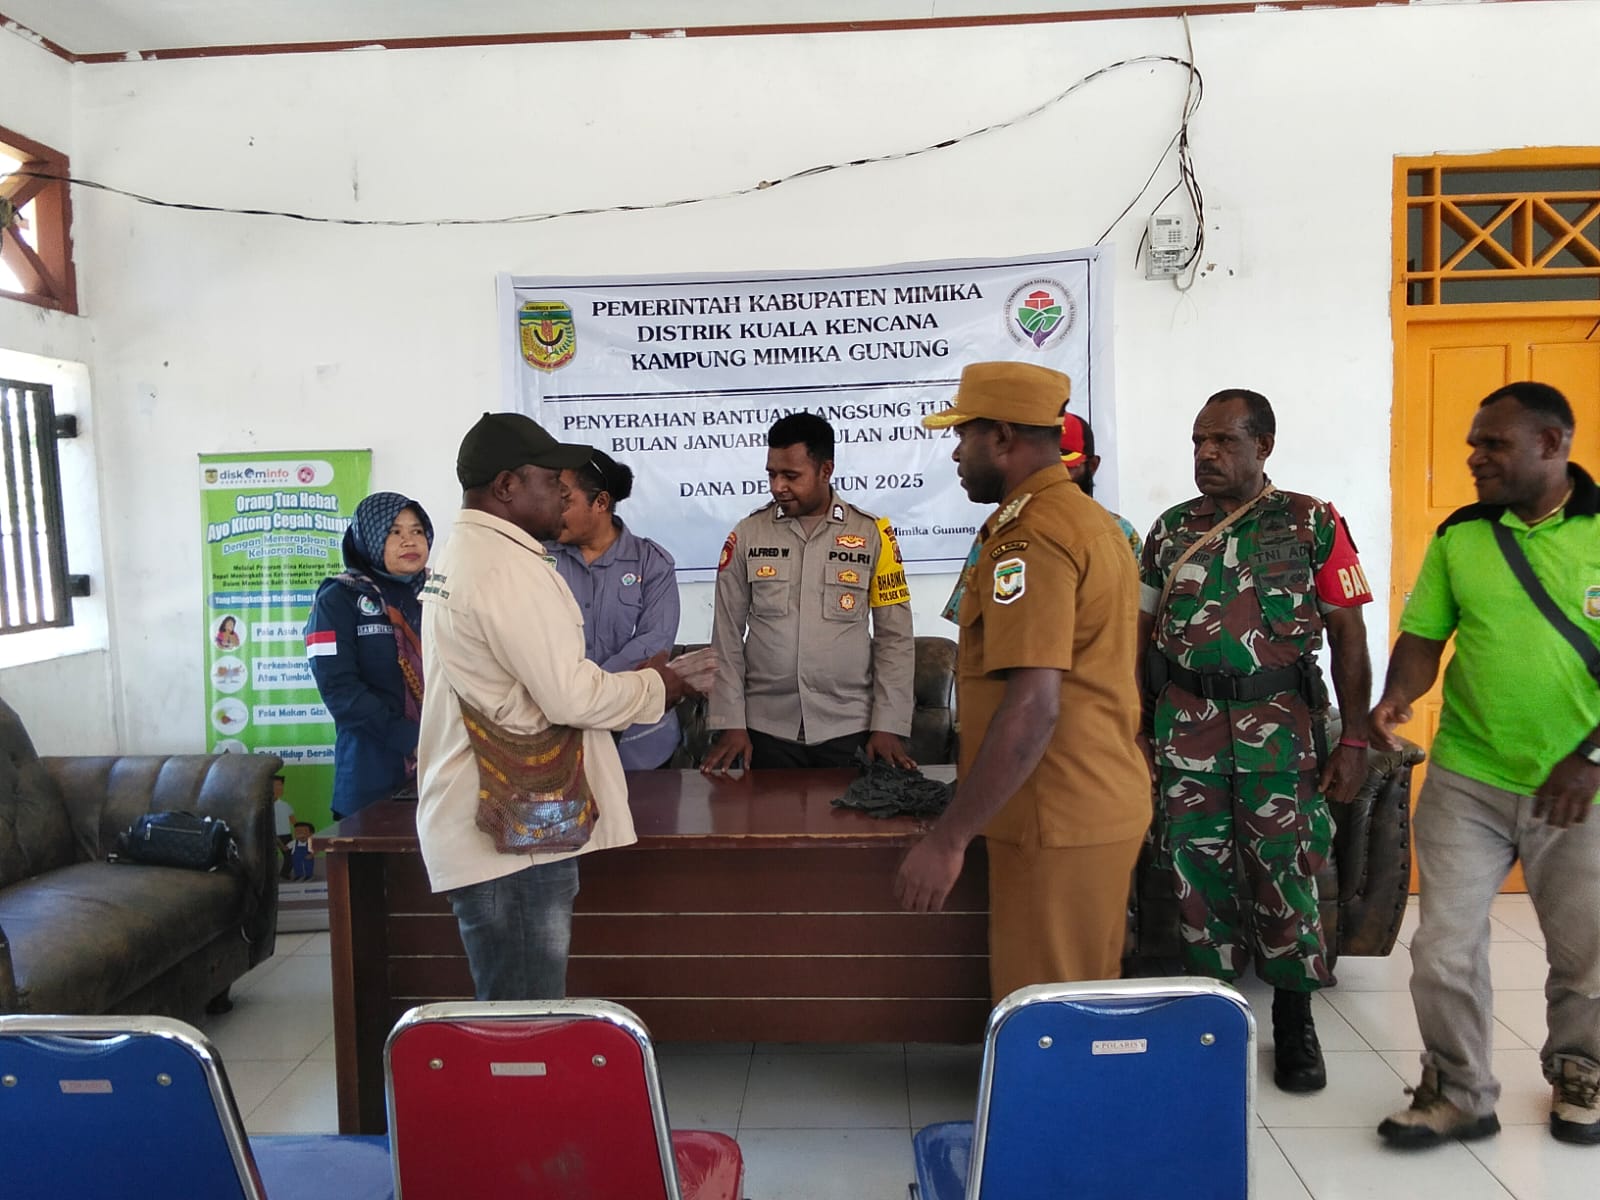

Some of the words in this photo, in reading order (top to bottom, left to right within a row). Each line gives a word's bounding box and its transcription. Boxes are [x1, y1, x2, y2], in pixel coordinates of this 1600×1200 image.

[591, 295, 741, 317] PEMERINTAH
[749, 288, 886, 313] KABUPATEN
[894, 283, 984, 305] MIMIKA
[637, 323, 733, 343] DISTRIK
[740, 320, 818, 339] KUALA
[825, 313, 939, 335] KENCANA
[631, 349, 747, 371] KAMPUNG
[753, 345, 842, 366] MIMIKA
[849, 338, 949, 361] GUNUNG
[563, 411, 696, 430] PENYERAHAN
[612, 436, 678, 453] BULAN
[680, 481, 736, 498] DANA
[742, 480, 771, 495] DE
[875, 473, 923, 491] 2025
[236, 494, 273, 512] Orang
[274, 491, 298, 510] Tua
[299, 491, 338, 511] Hebat
[207, 522, 231, 542] Ayo
[231, 514, 272, 535] Kitong
[273, 512, 313, 530] Cegah
[223, 538, 261, 554] Dengan
[248, 546, 294, 558] Keluarga
[296, 545, 327, 557] Balita
[748, 547, 780, 558] ALFRED
[781, 547, 790, 558] W
[828, 551, 870, 564] POLRI
[1254, 551, 1281, 564] TNI
[281, 672, 312, 681] Tumbuh
[279, 708, 307, 717] Makan
[280, 750, 304, 762] Hidup
[306, 748, 335, 758] Bersih
